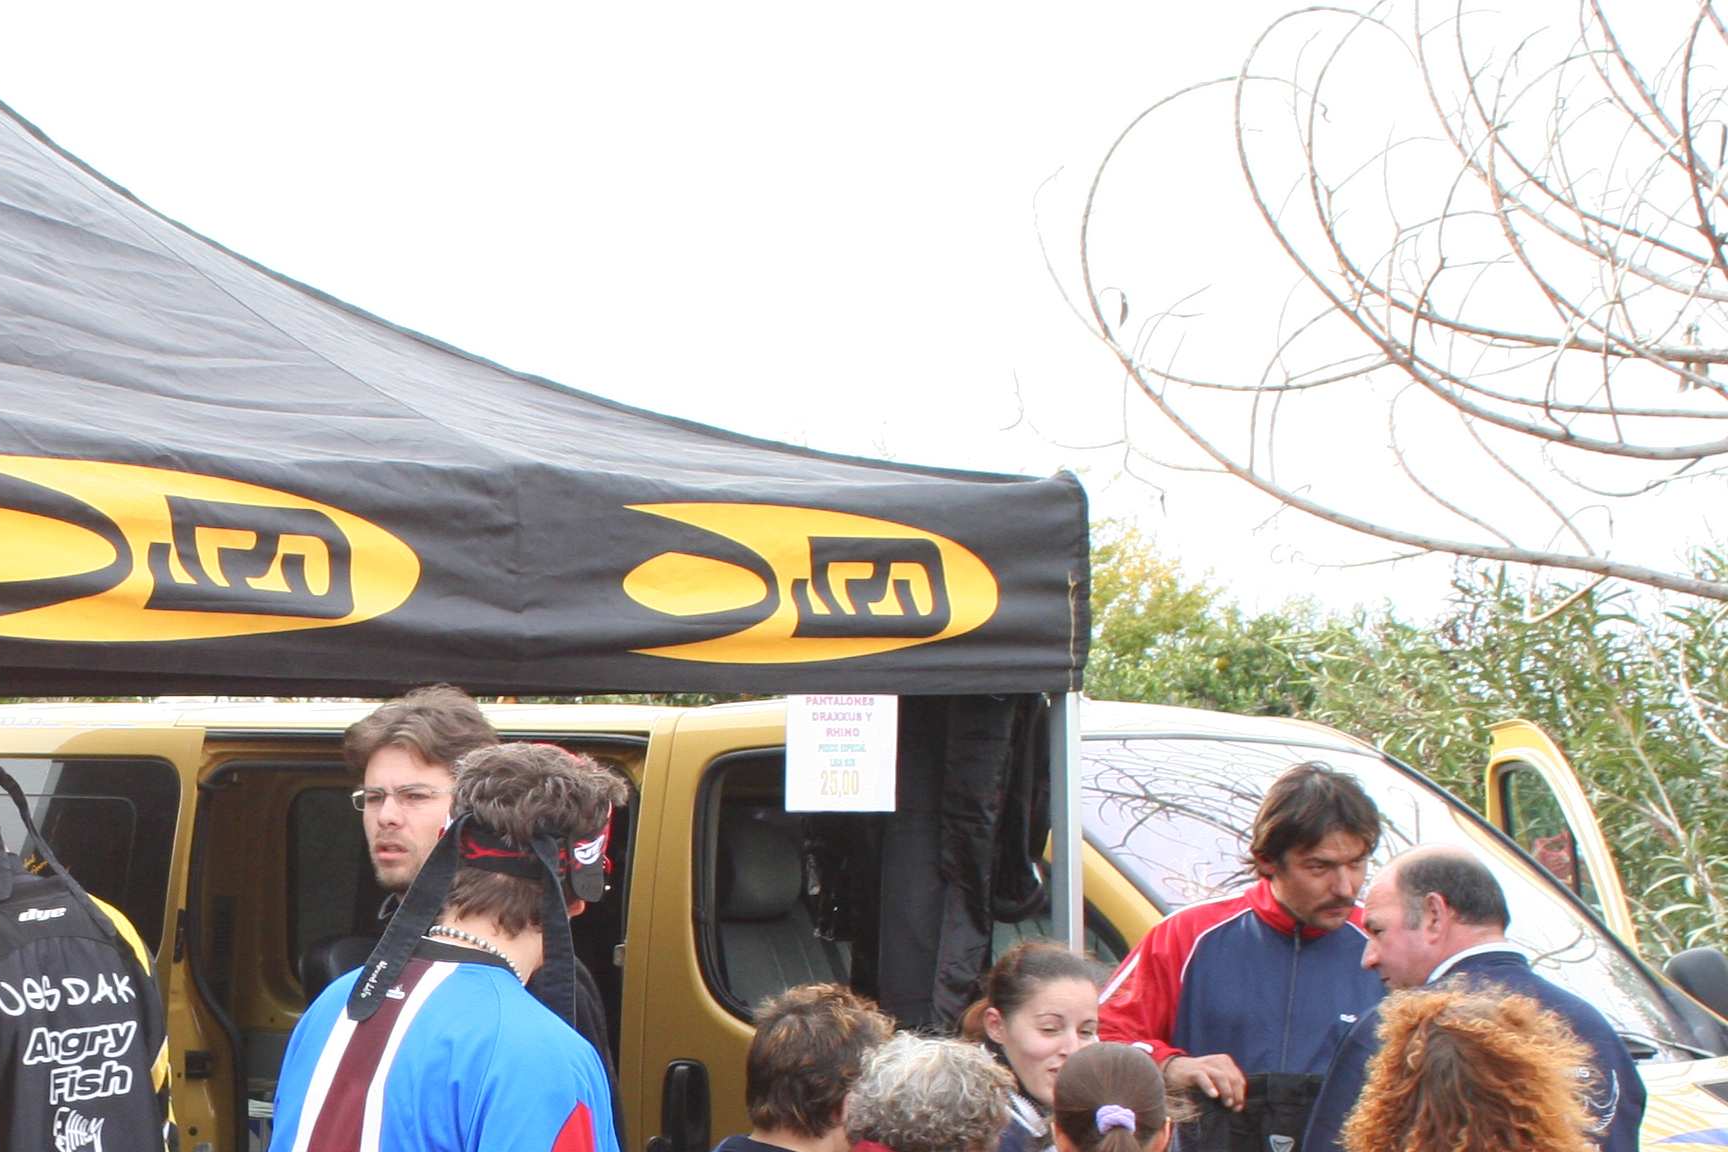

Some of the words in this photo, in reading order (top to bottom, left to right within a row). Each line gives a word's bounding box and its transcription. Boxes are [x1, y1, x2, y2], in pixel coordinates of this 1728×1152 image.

[805, 696, 875, 707] PANTALONES
[812, 711, 863, 722] DRAXXUS
[864, 711, 873, 722] Y
[825, 728, 861, 738] RHINO
[820, 769, 860, 798] 25,00
[23, 1020, 137, 1066] Angry
[49, 1060, 133, 1105] Fish
